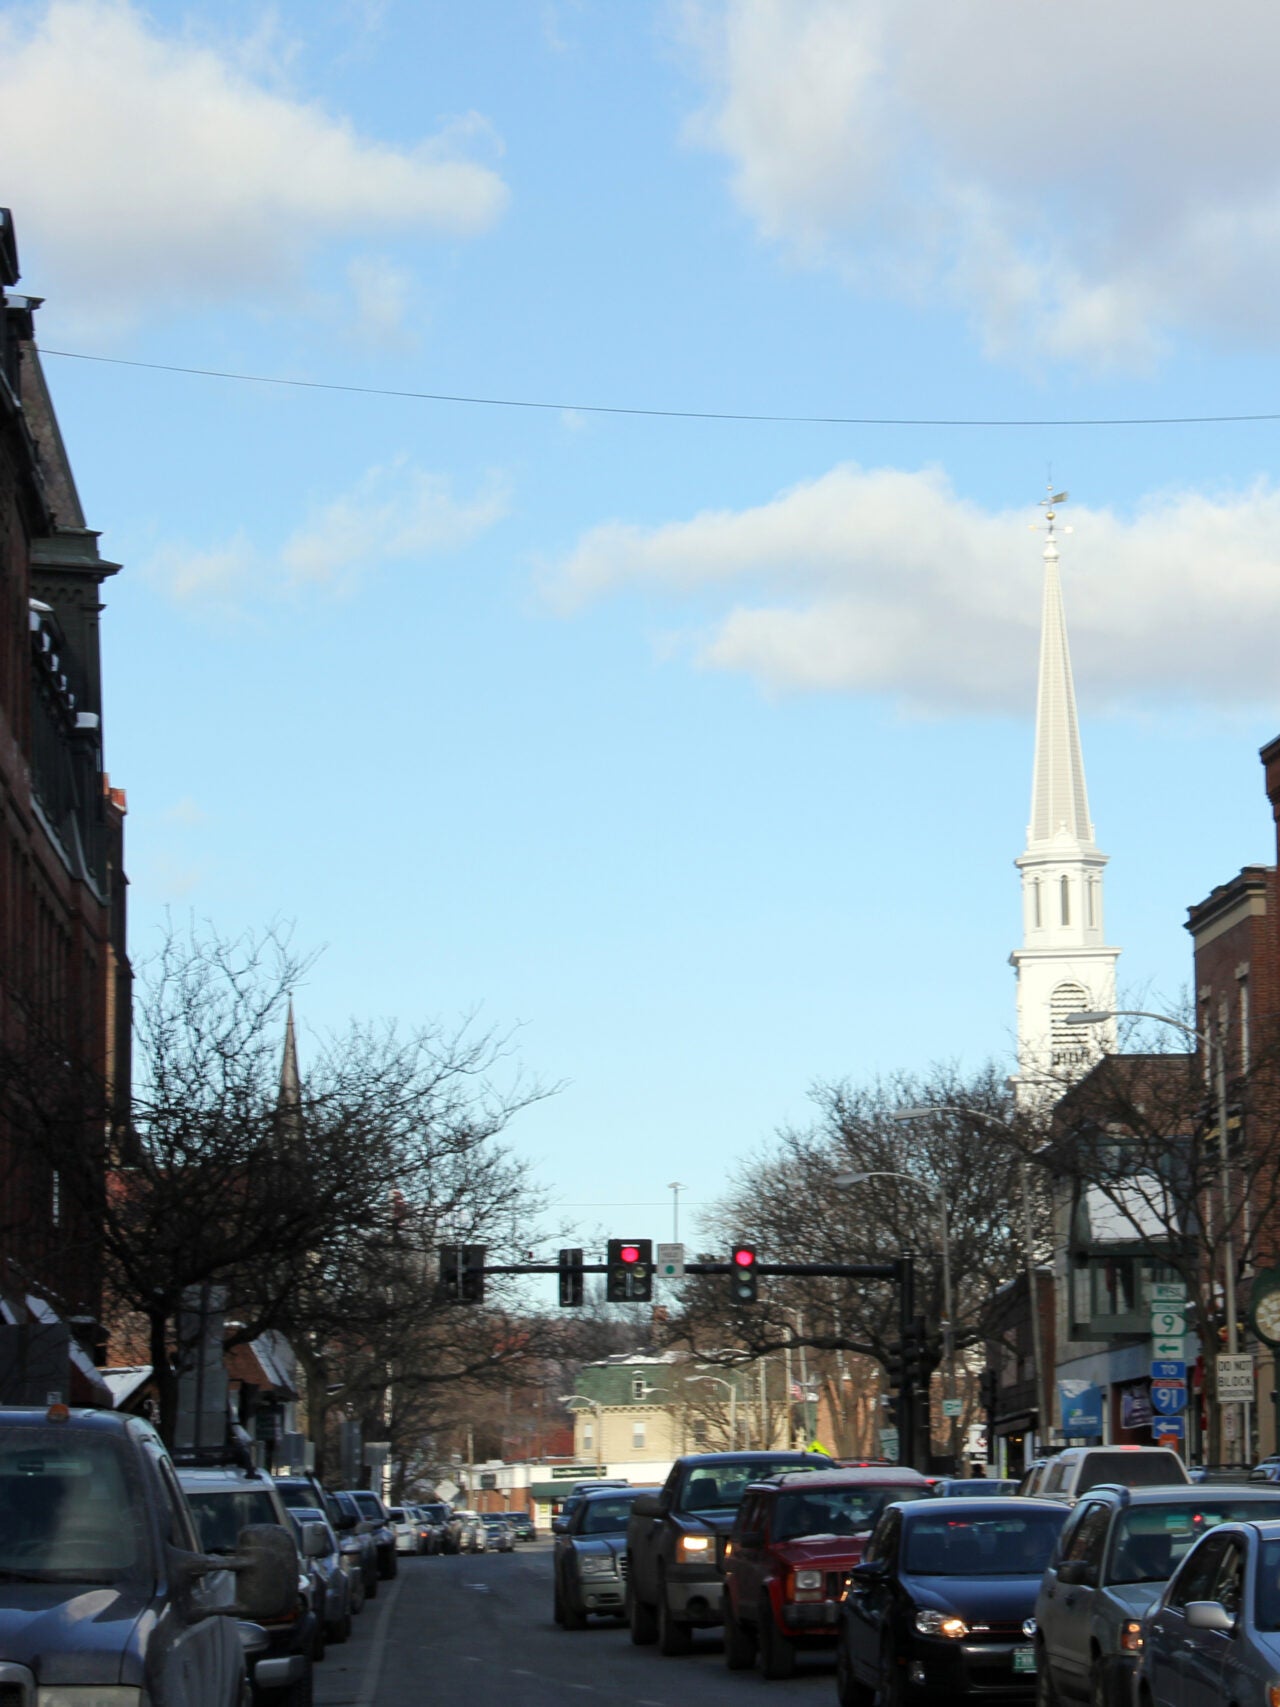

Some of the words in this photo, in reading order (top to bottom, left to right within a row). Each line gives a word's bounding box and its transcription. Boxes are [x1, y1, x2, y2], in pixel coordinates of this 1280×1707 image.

[1161, 1315, 1175, 1333] 9
[1160, 1364, 1177, 1375] TO
[1218, 1361, 1231, 1371] DO
[1234, 1360, 1252, 1371] NOT
[1217, 1377, 1251, 1387] BLOCK
[1157, 1389, 1178, 1408] 91
